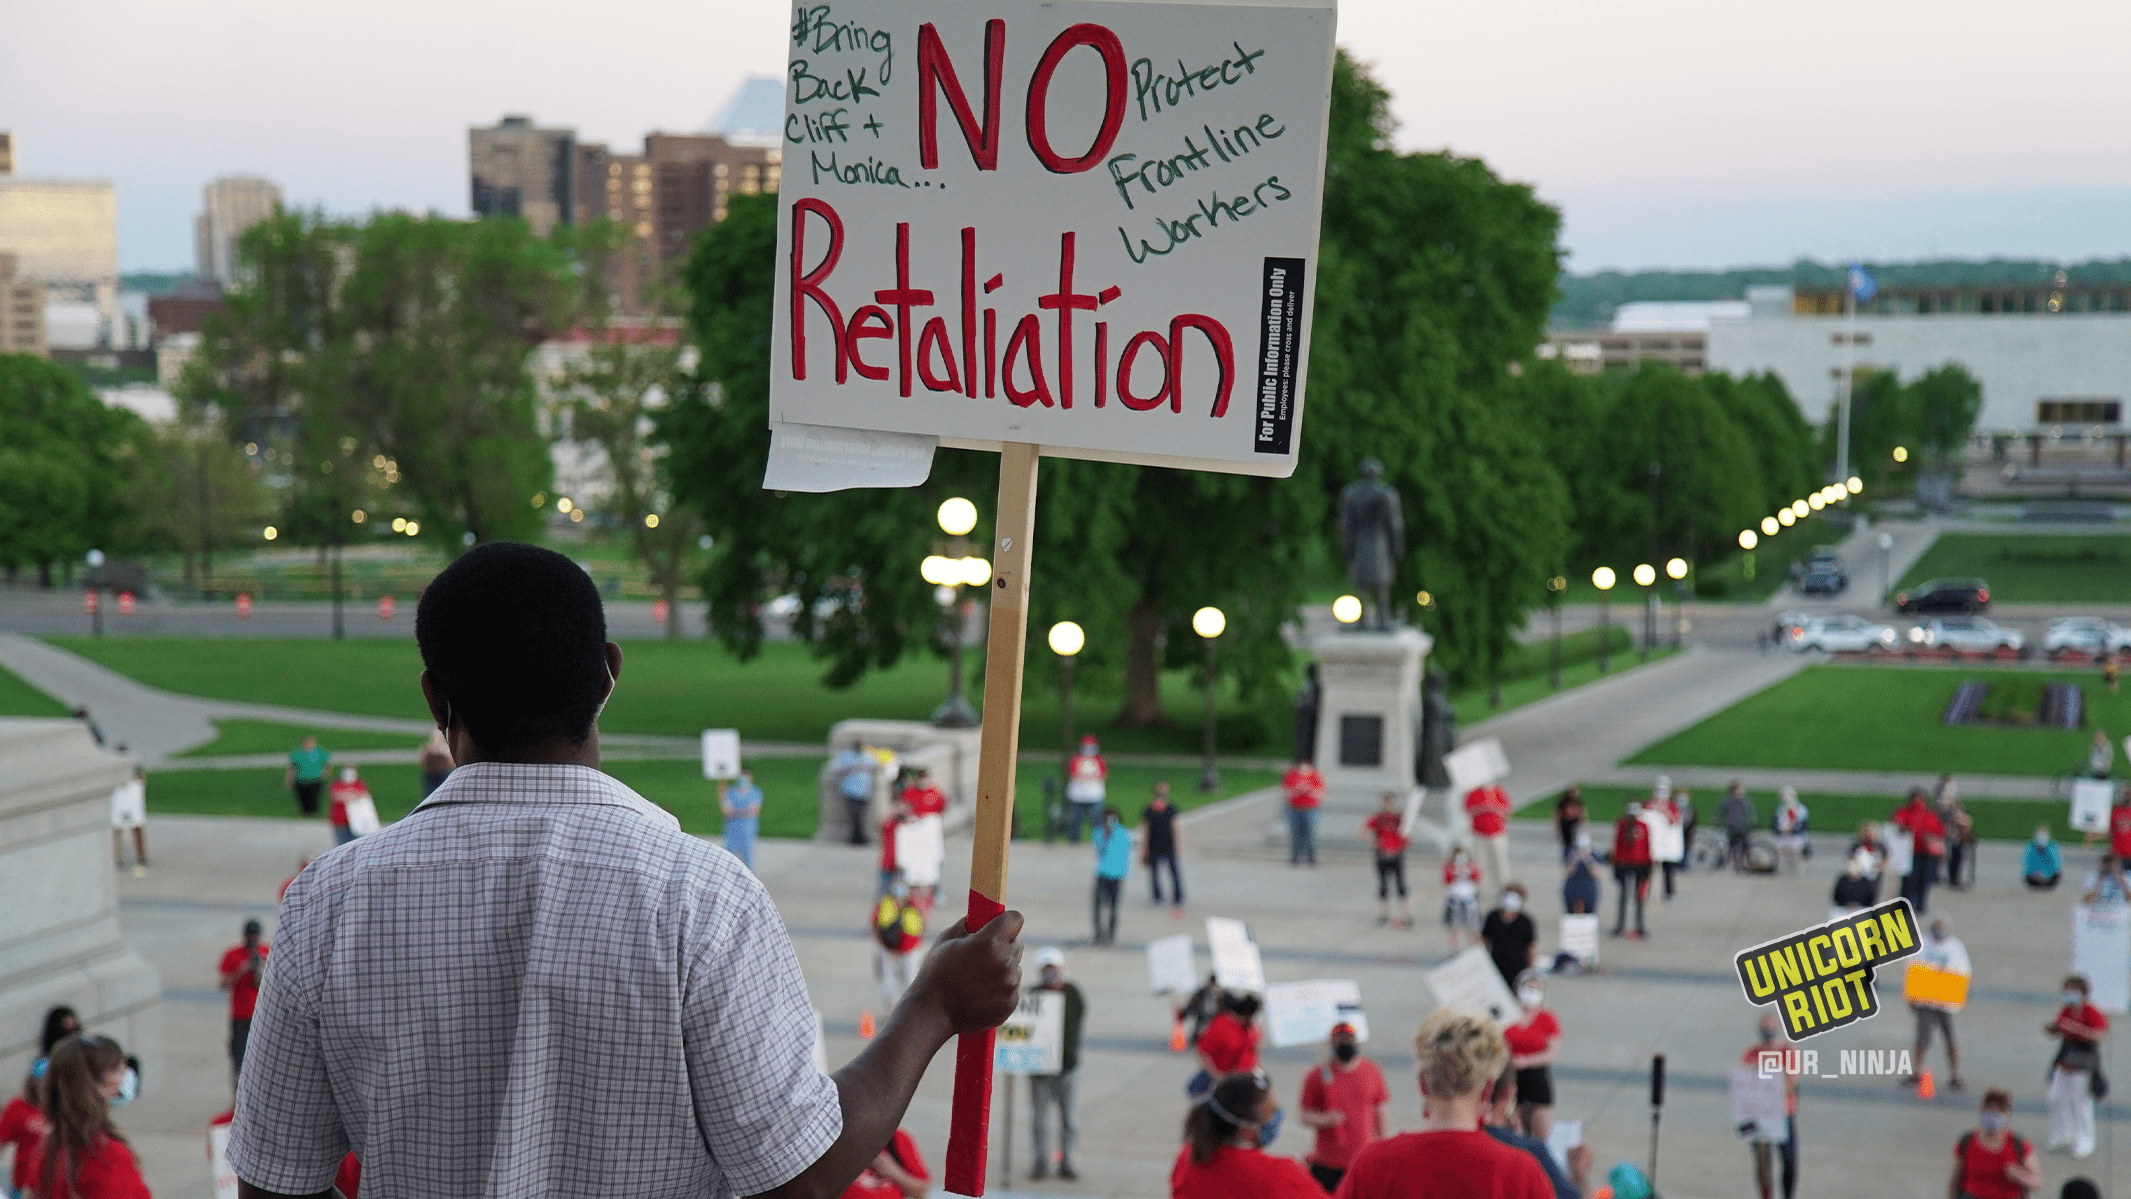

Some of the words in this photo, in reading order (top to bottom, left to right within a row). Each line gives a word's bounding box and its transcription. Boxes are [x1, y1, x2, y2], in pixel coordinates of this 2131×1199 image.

[792, 5, 893, 86] #Bring
[788, 59, 880, 104] Back
[917, 18, 1128, 174] NO
[1131, 41, 1265, 122] Protect
[785, 108, 850, 143] Cliff
[863, 113, 884, 139] +
[1108, 114, 1286, 210] Frontline
[1119, 176, 1291, 263] Workers
[1269, 267, 1287, 297] Only
[1287, 291, 1295, 316] deliver
[790, 197, 1235, 418] Retaliation
[1263, 299, 1283, 376] Information
[1285, 333, 1293, 352] cross
[1282, 353, 1291, 378] please
[1261, 378, 1278, 419] Public
[1279, 379, 1289, 420] Employees:
[1259, 421, 1274, 442] For
